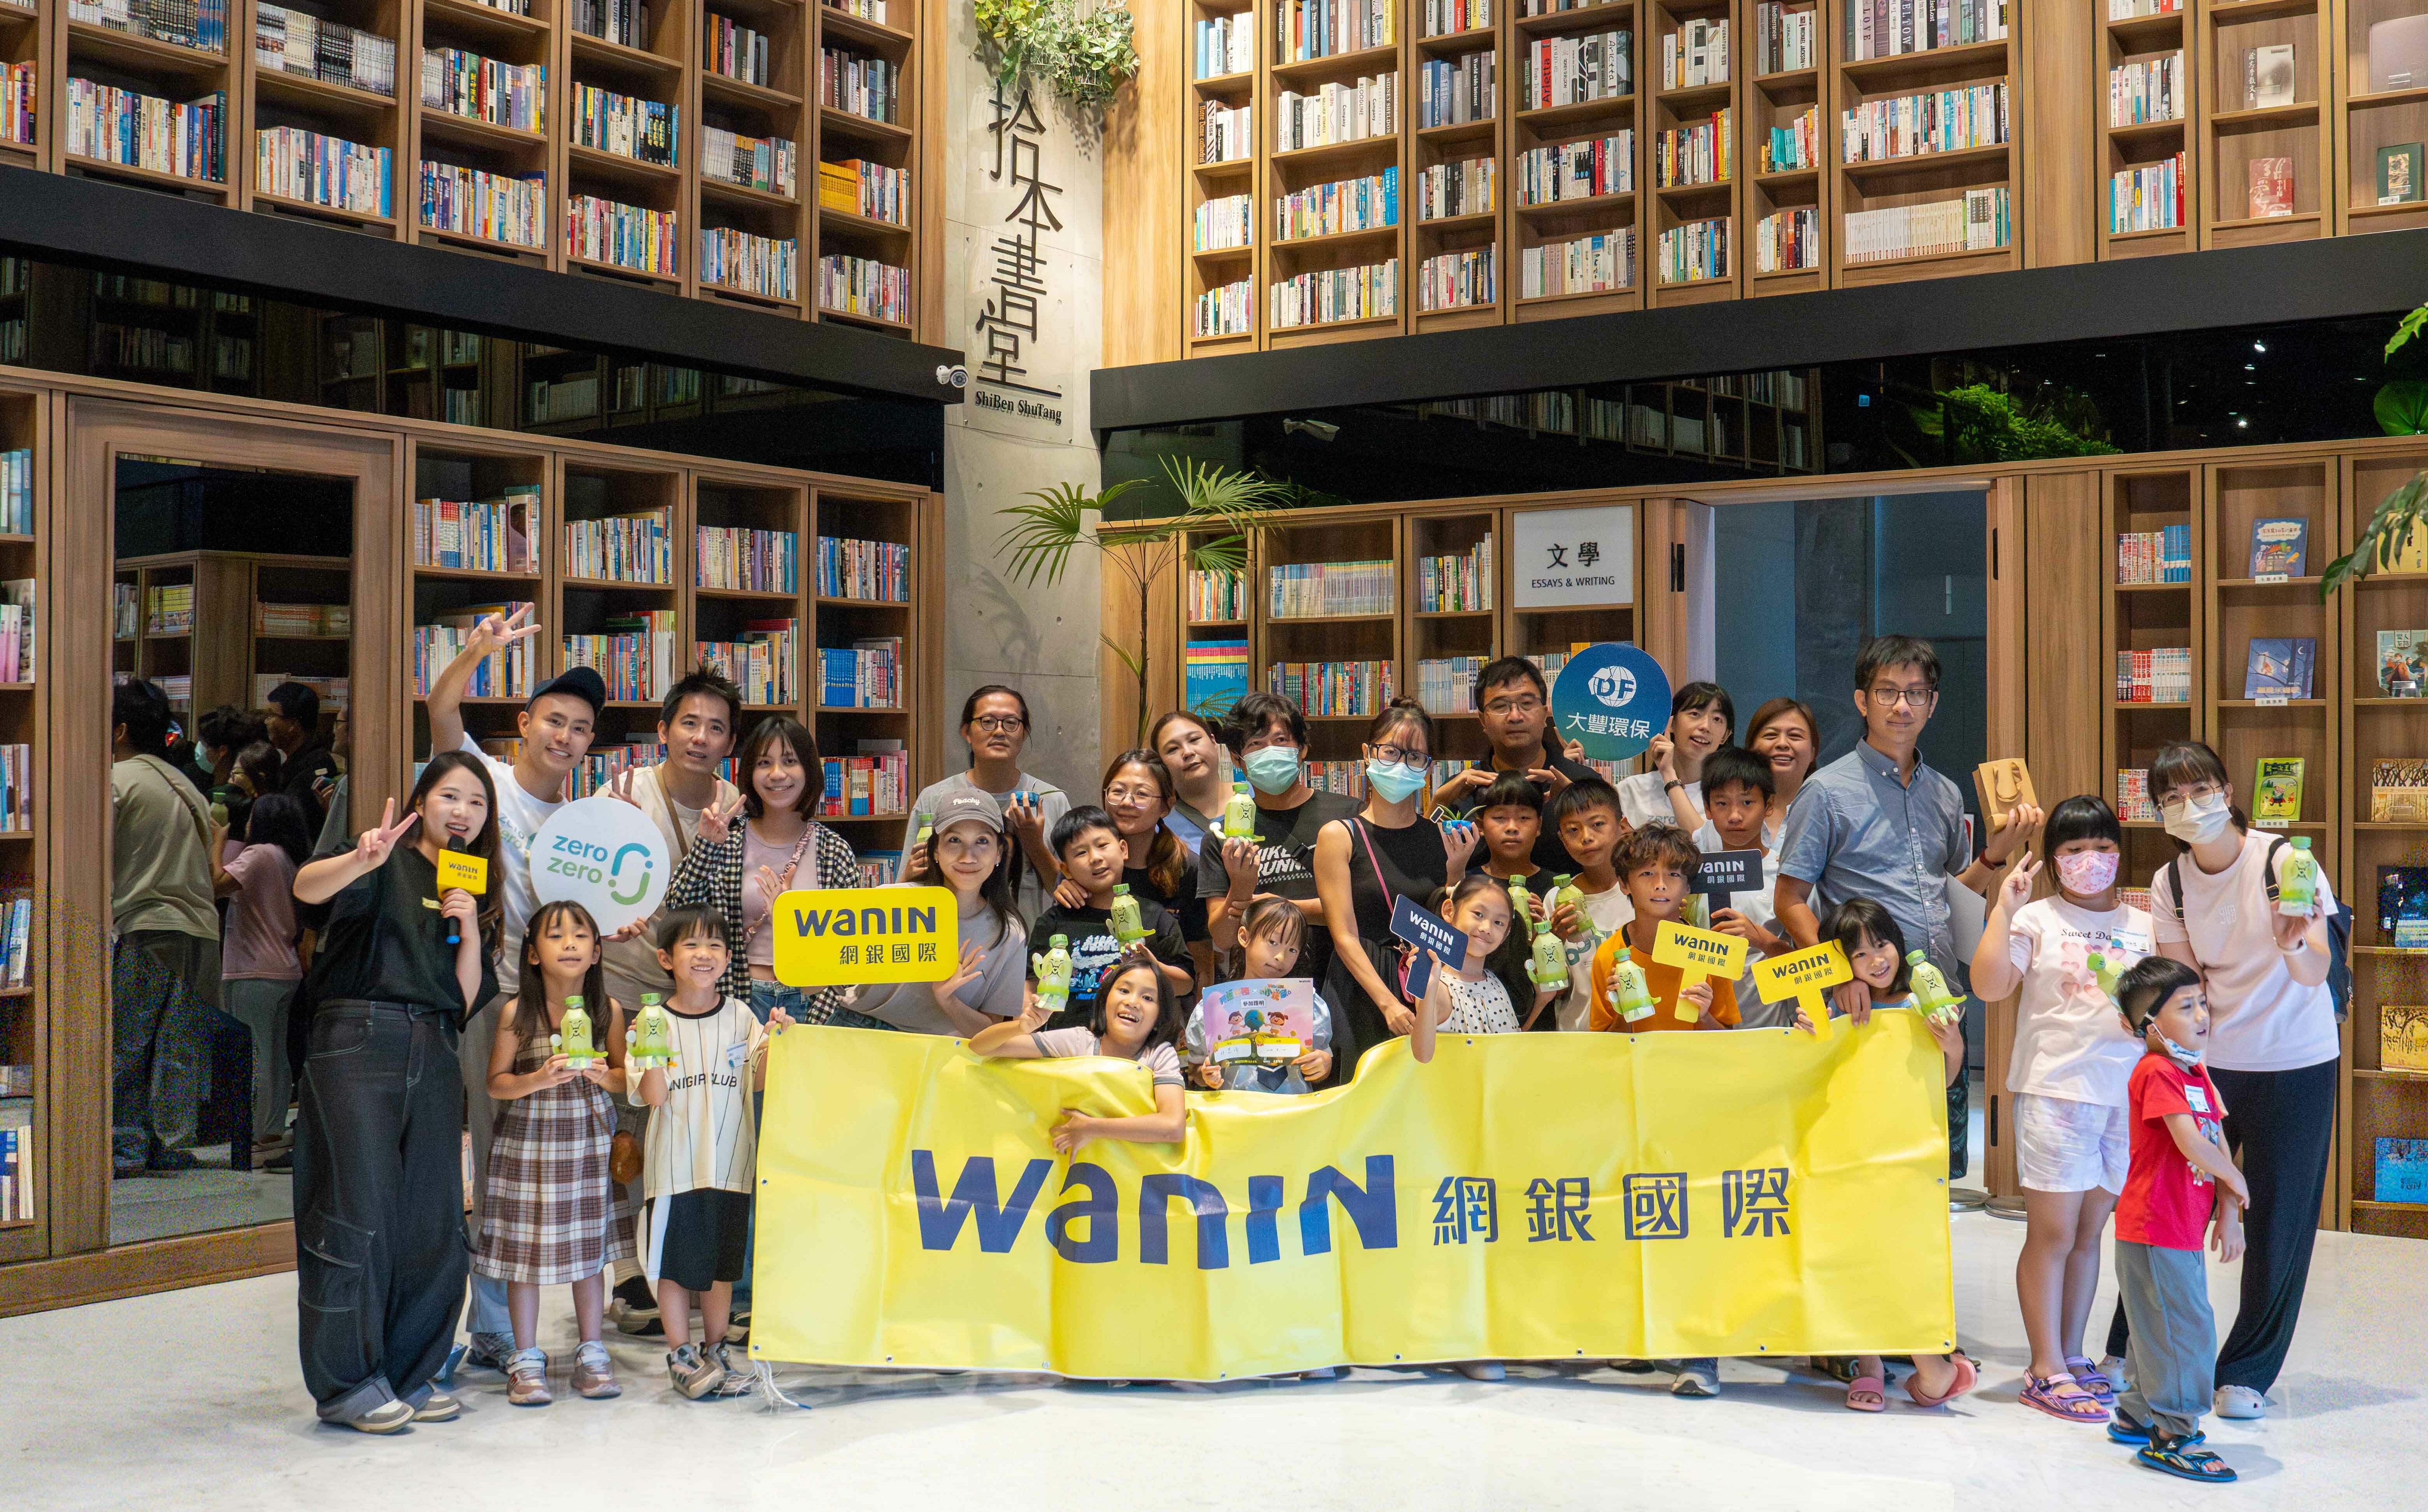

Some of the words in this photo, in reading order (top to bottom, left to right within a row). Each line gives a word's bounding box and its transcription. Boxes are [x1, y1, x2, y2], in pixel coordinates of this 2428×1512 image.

[1542, 58, 1551, 103] Arletta
[975, 78, 1063, 398] 拾本書堂
[975, 391, 1014, 411] ShiBen
[1018, 399, 1062, 425] ShuTang
[1546, 541, 1600, 569] 文學
[1531, 578, 1563, 588] ESSAYS
[1565, 578, 1573, 587] &
[1576, 576, 1615, 586] WRITING
[1566, 712, 1650, 739] 大豐環保
[953, 797, 981, 806] Peachy
[552, 835, 608, 862] zero
[546, 857, 603, 884] zero
[1419, 932, 1451, 956] 網銀國際
[2061, 928, 2092, 938] Sweet
[839, 943, 937, 965] 網銀國際
[1687, 951, 1726, 967] 網銀國際
[1794, 967, 1833, 985] 網銀國際
[669, 1074, 706, 1091] NIGIR
[1432, 1167, 1792, 1246] 網銀國際
